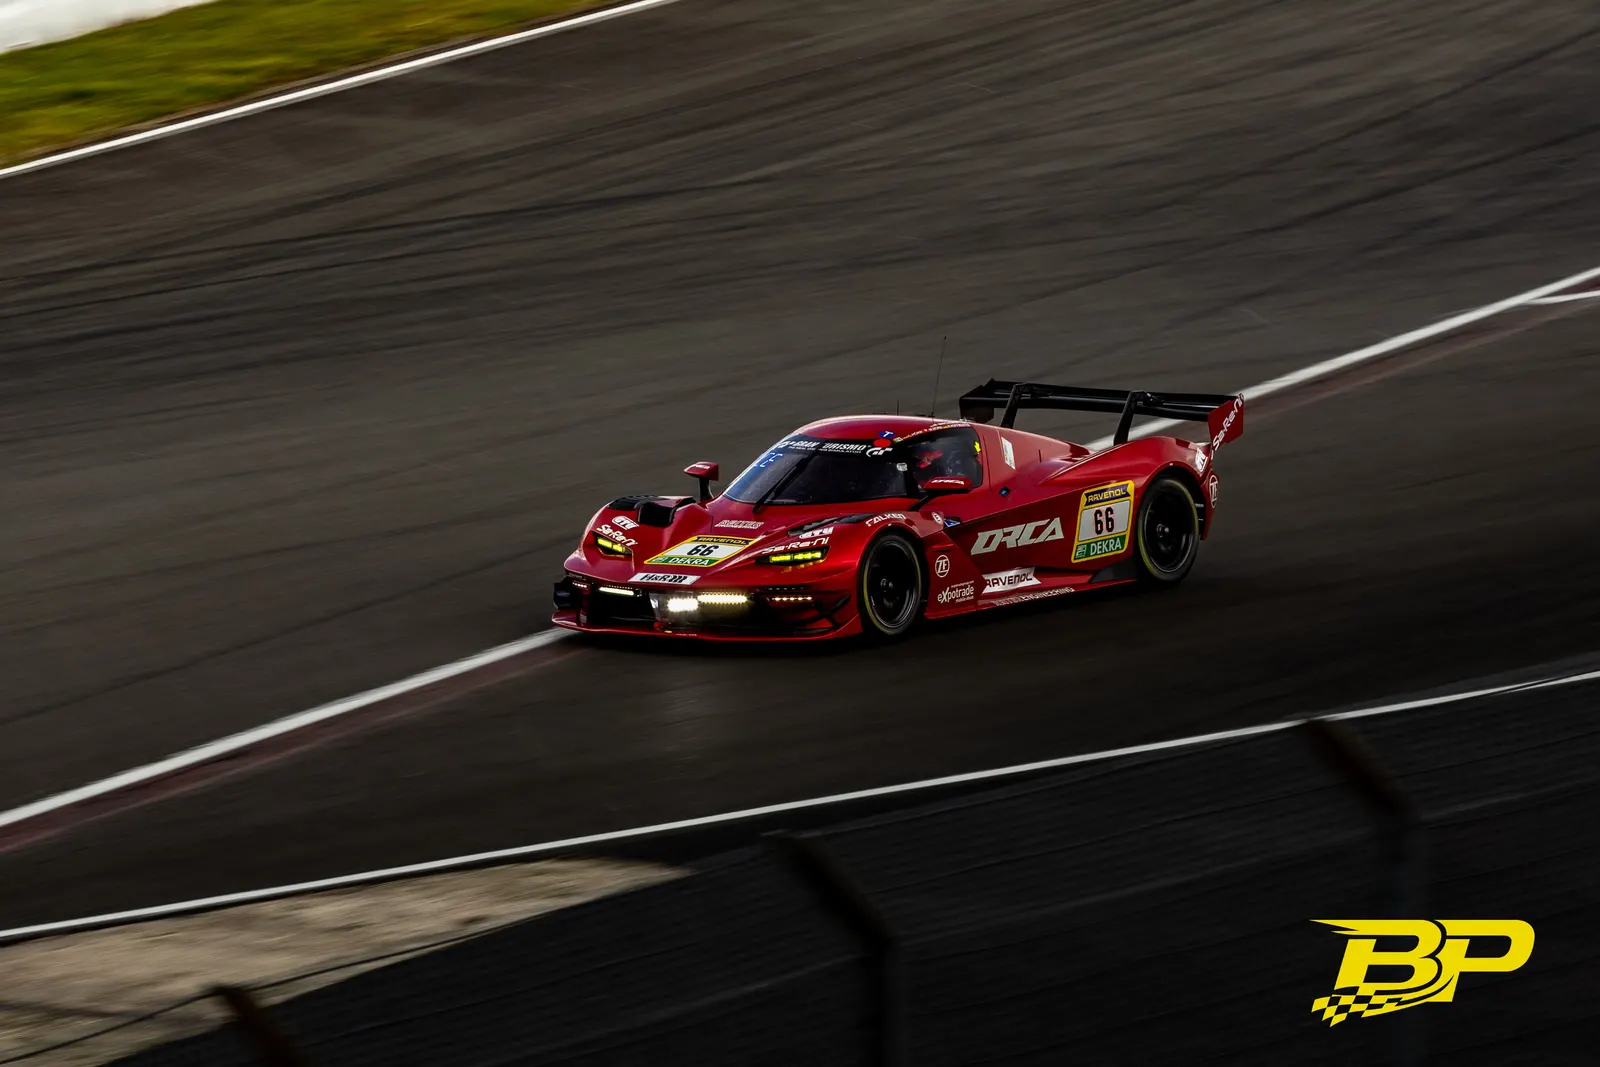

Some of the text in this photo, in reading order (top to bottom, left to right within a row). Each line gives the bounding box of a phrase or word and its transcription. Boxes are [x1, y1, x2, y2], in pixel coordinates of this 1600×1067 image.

[1088, 488, 1126, 503] RAVENOL
[865, 513, 907, 527] FALKEN
[1094, 506, 1115, 535] 66
[698, 536, 748, 545] RAVENOL
[971, 516, 1065, 555] ORCA
[686, 544, 719, 556] 66
[1090, 537, 1122, 556] DEKRA
[668, 557, 709, 566] DEKRA
[935, 557, 950, 575] ZF
[984, 572, 1033, 589] RAVENOL
